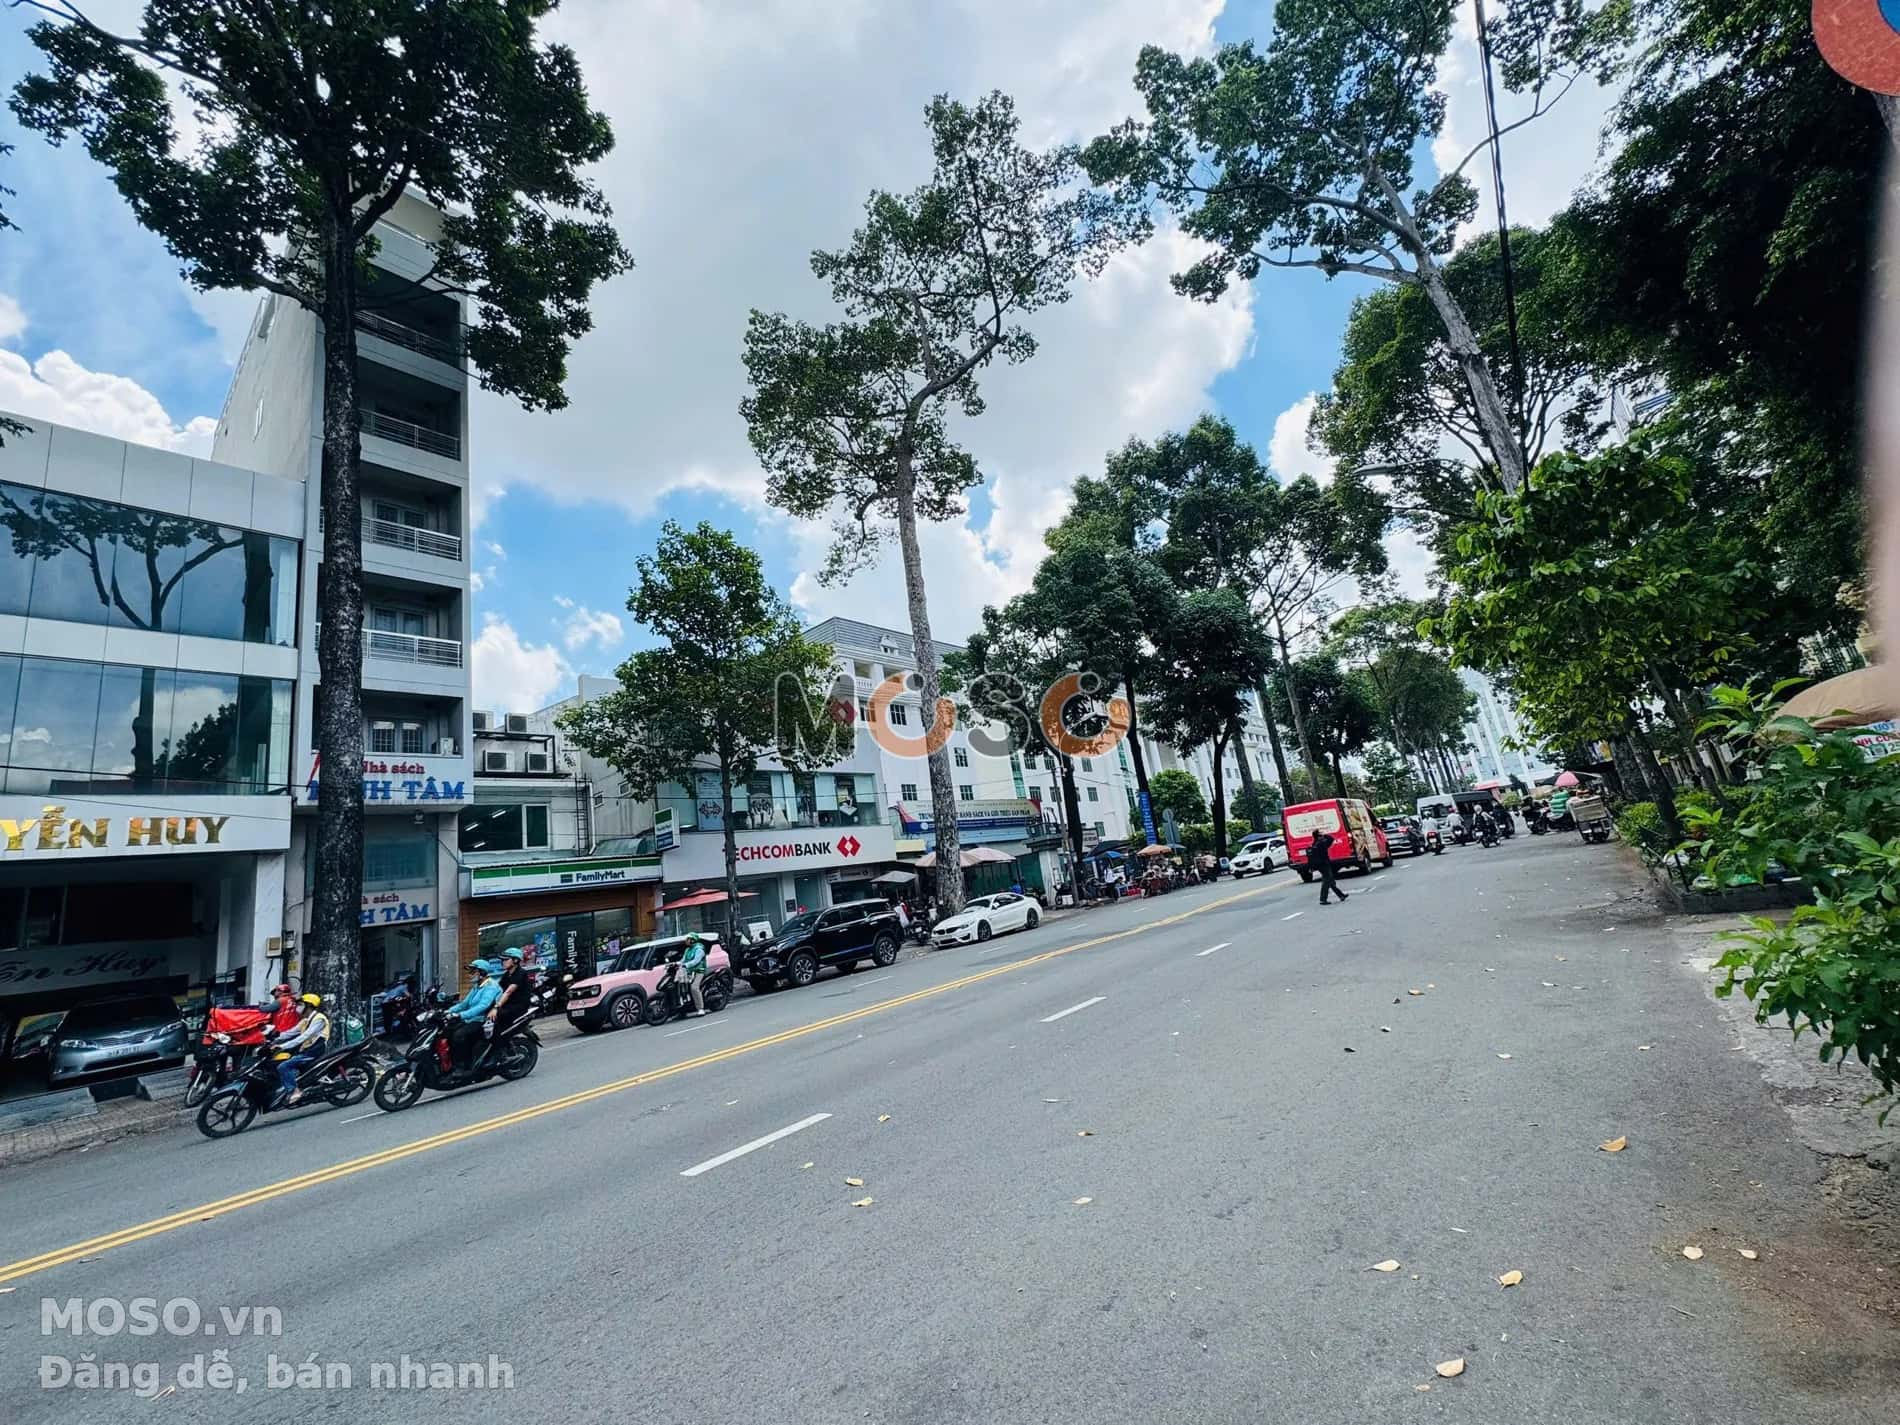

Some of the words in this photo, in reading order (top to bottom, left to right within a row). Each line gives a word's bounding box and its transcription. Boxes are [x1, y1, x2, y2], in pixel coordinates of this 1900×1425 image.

[391, 760, 425, 775] sách
[402, 776, 465, 800] TÂM
[126, 815, 230, 846] HUY
[722, 841, 832, 861] ECHCOMBANK
[576, 869, 625, 882] FamilyMart
[380, 902, 430, 922] TÂM
